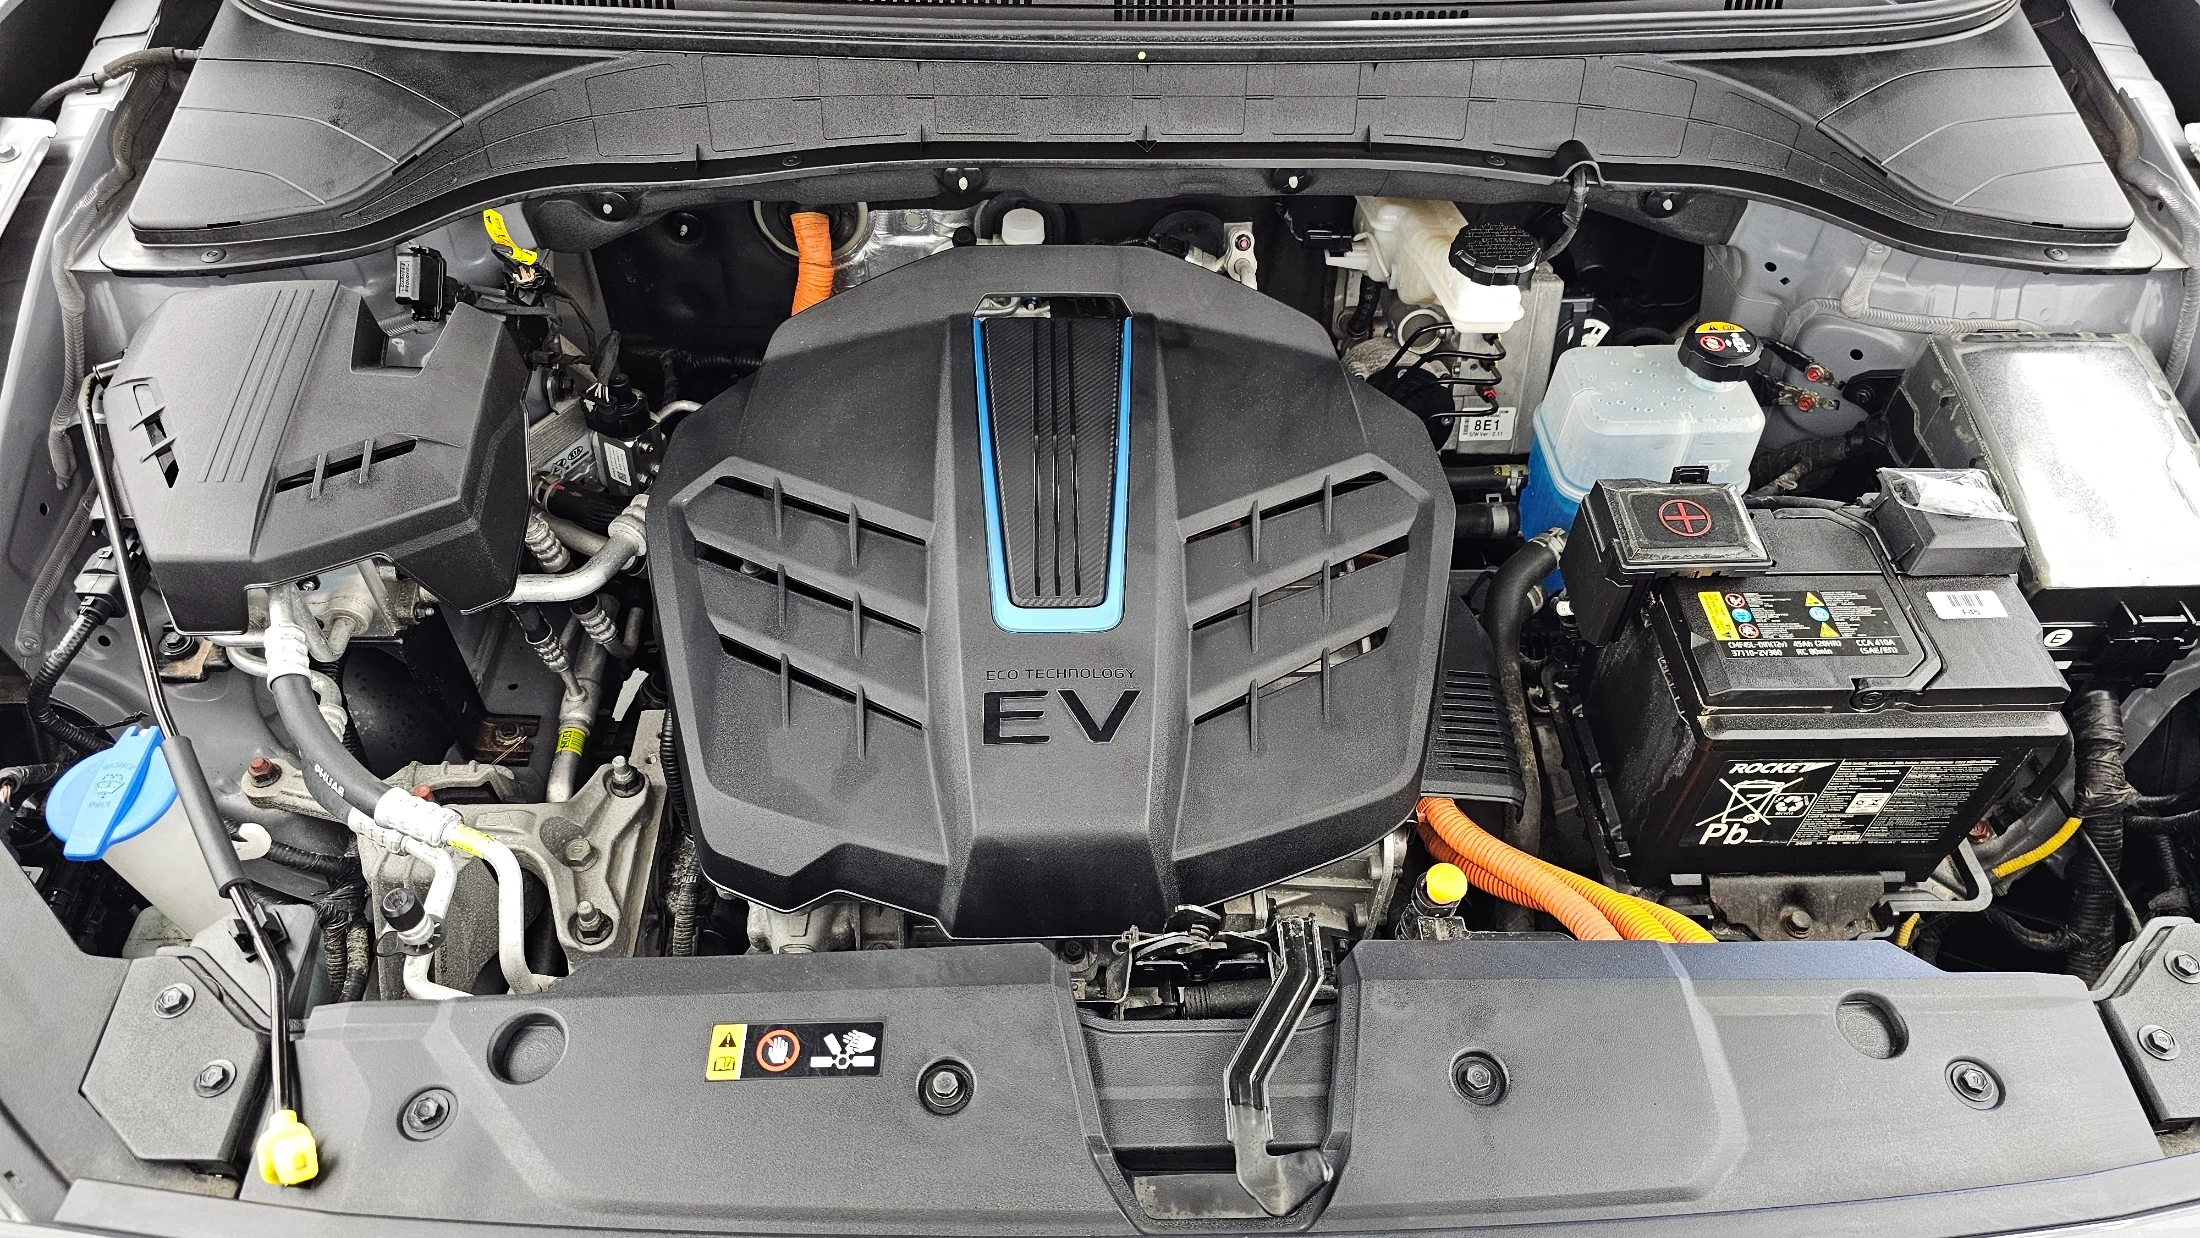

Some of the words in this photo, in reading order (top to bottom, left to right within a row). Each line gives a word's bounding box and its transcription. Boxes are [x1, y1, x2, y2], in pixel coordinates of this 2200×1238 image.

[1474, 419, 1500, 431] 8E1
[569, 447, 583, 460] KIA
[2050, 633, 2066, 644] E
[986, 670, 1018, 680] ECO
[1025, 668, 1136, 680] TECHNOLOGY
[983, 689, 1142, 745] EV
[1728, 762, 1836, 774] ROCKET
[1699, 823, 1749, 845] Pb
